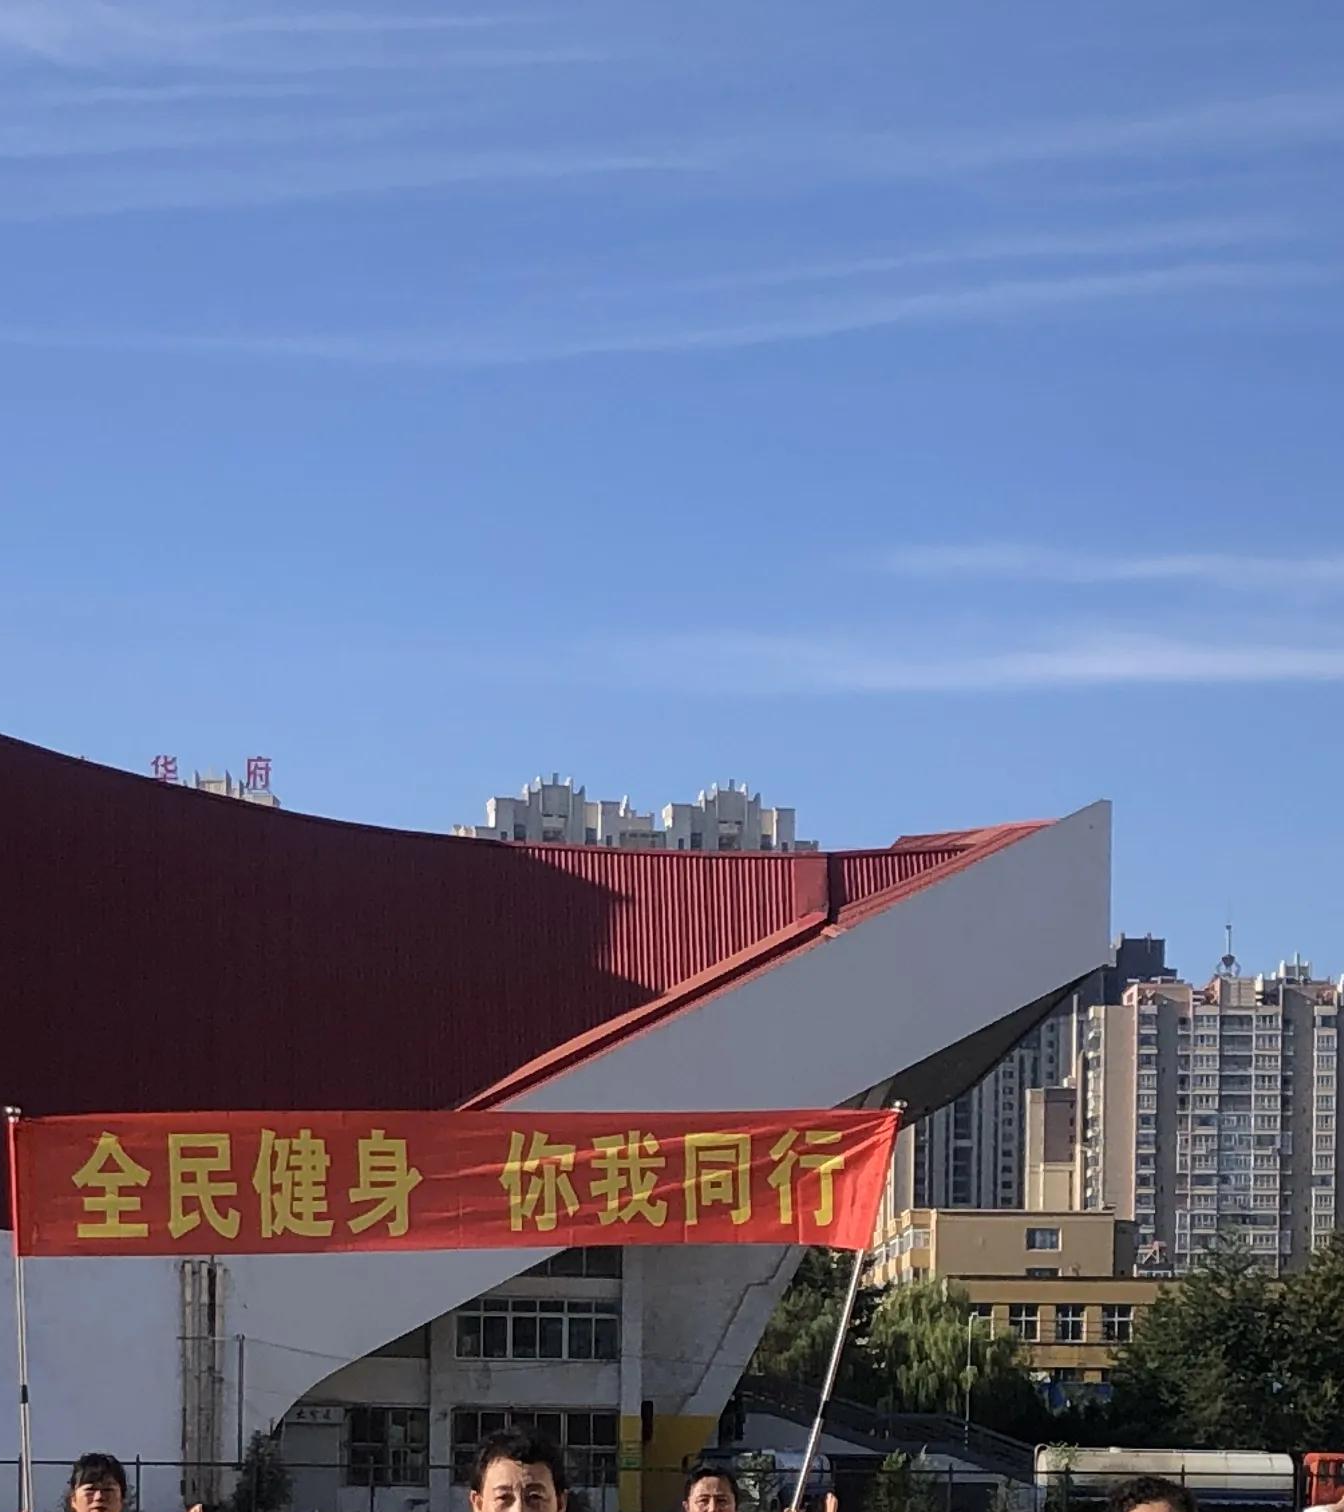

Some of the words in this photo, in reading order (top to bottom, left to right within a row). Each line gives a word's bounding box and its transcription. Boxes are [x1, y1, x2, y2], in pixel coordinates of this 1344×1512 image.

[151, 755, 272, 789] 华府
[72, 1128, 425, 1240] 全民健身
[500, 1128, 846, 1232] 你我同行
